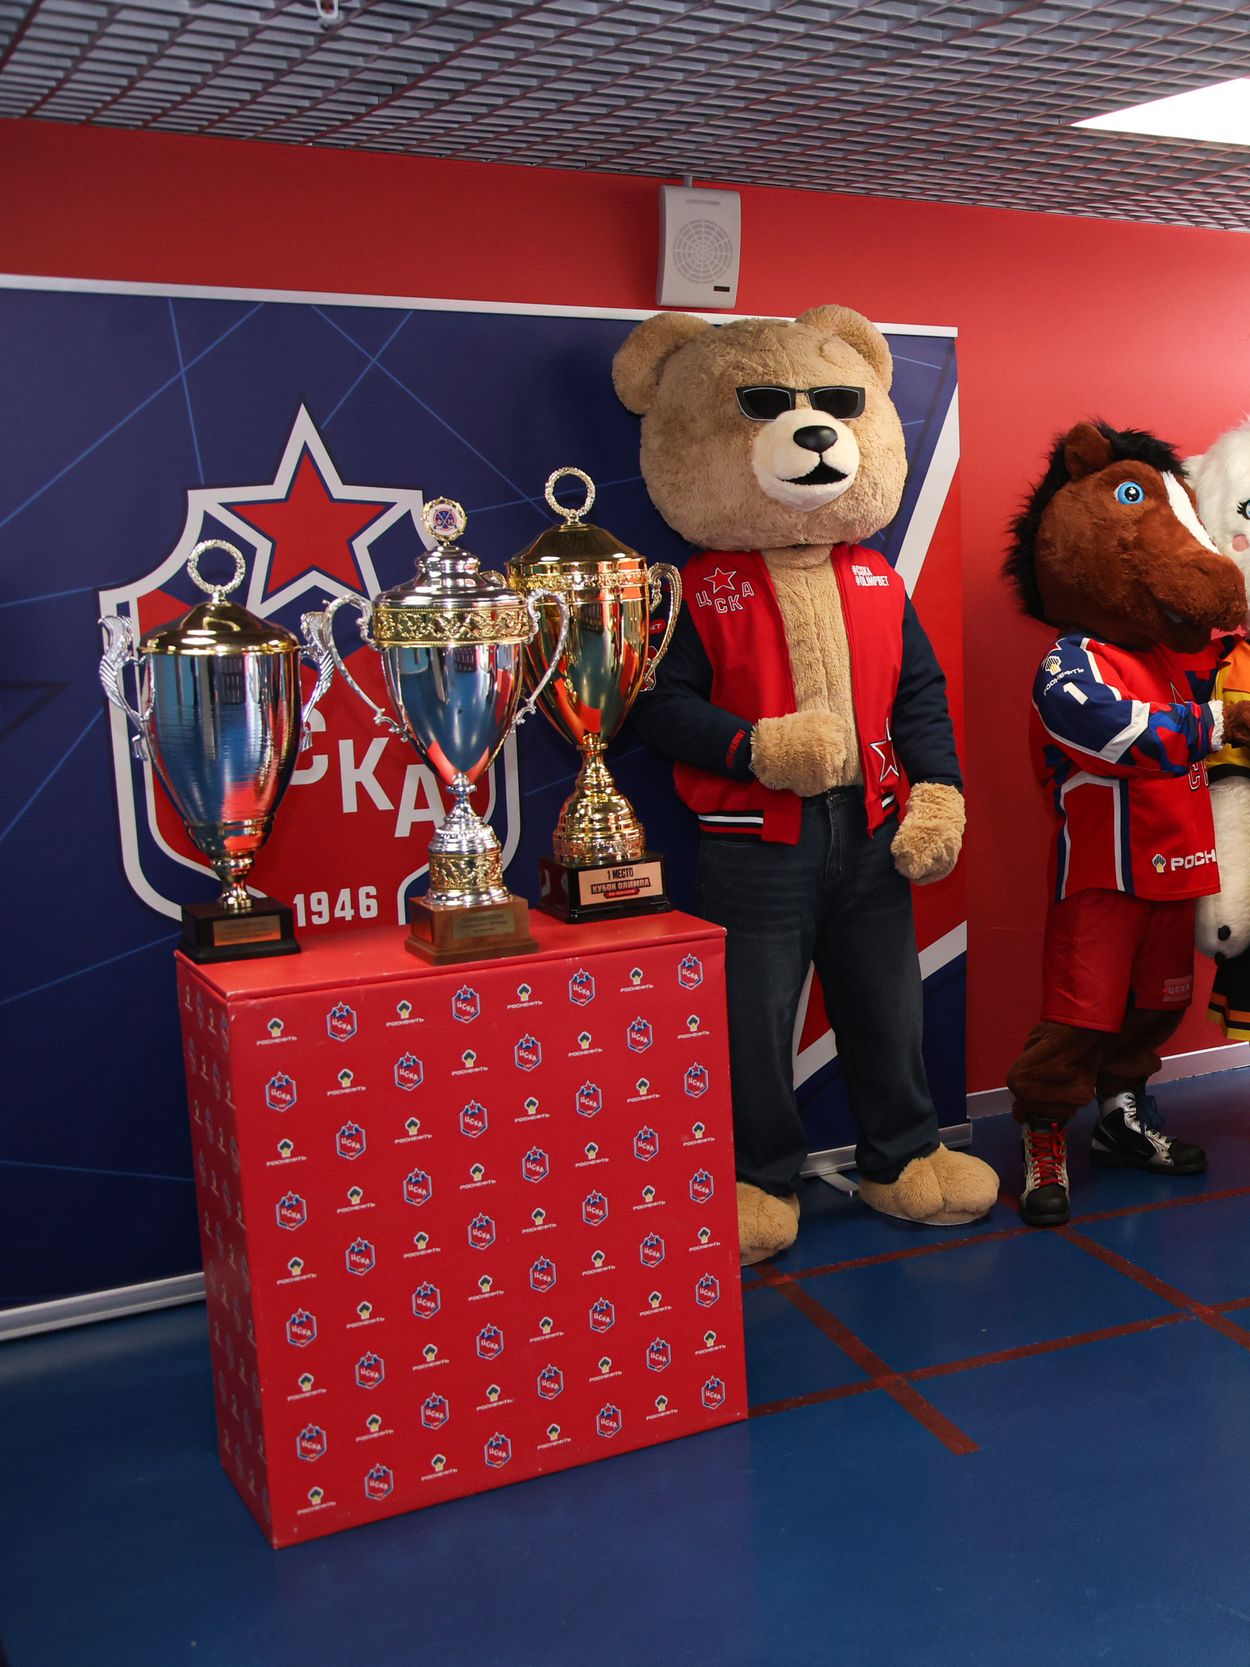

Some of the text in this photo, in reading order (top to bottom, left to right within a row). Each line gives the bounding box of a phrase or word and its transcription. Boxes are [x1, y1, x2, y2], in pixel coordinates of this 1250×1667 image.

[695, 581, 755, 614] ЦСКА
[1062, 681, 1089, 706] 1
[291, 708, 449, 838] СКА
[612, 867, 634, 880] МЕСТО
[1170, 848, 1218, 872] РОСН
[293, 885, 378, 927] 1946
